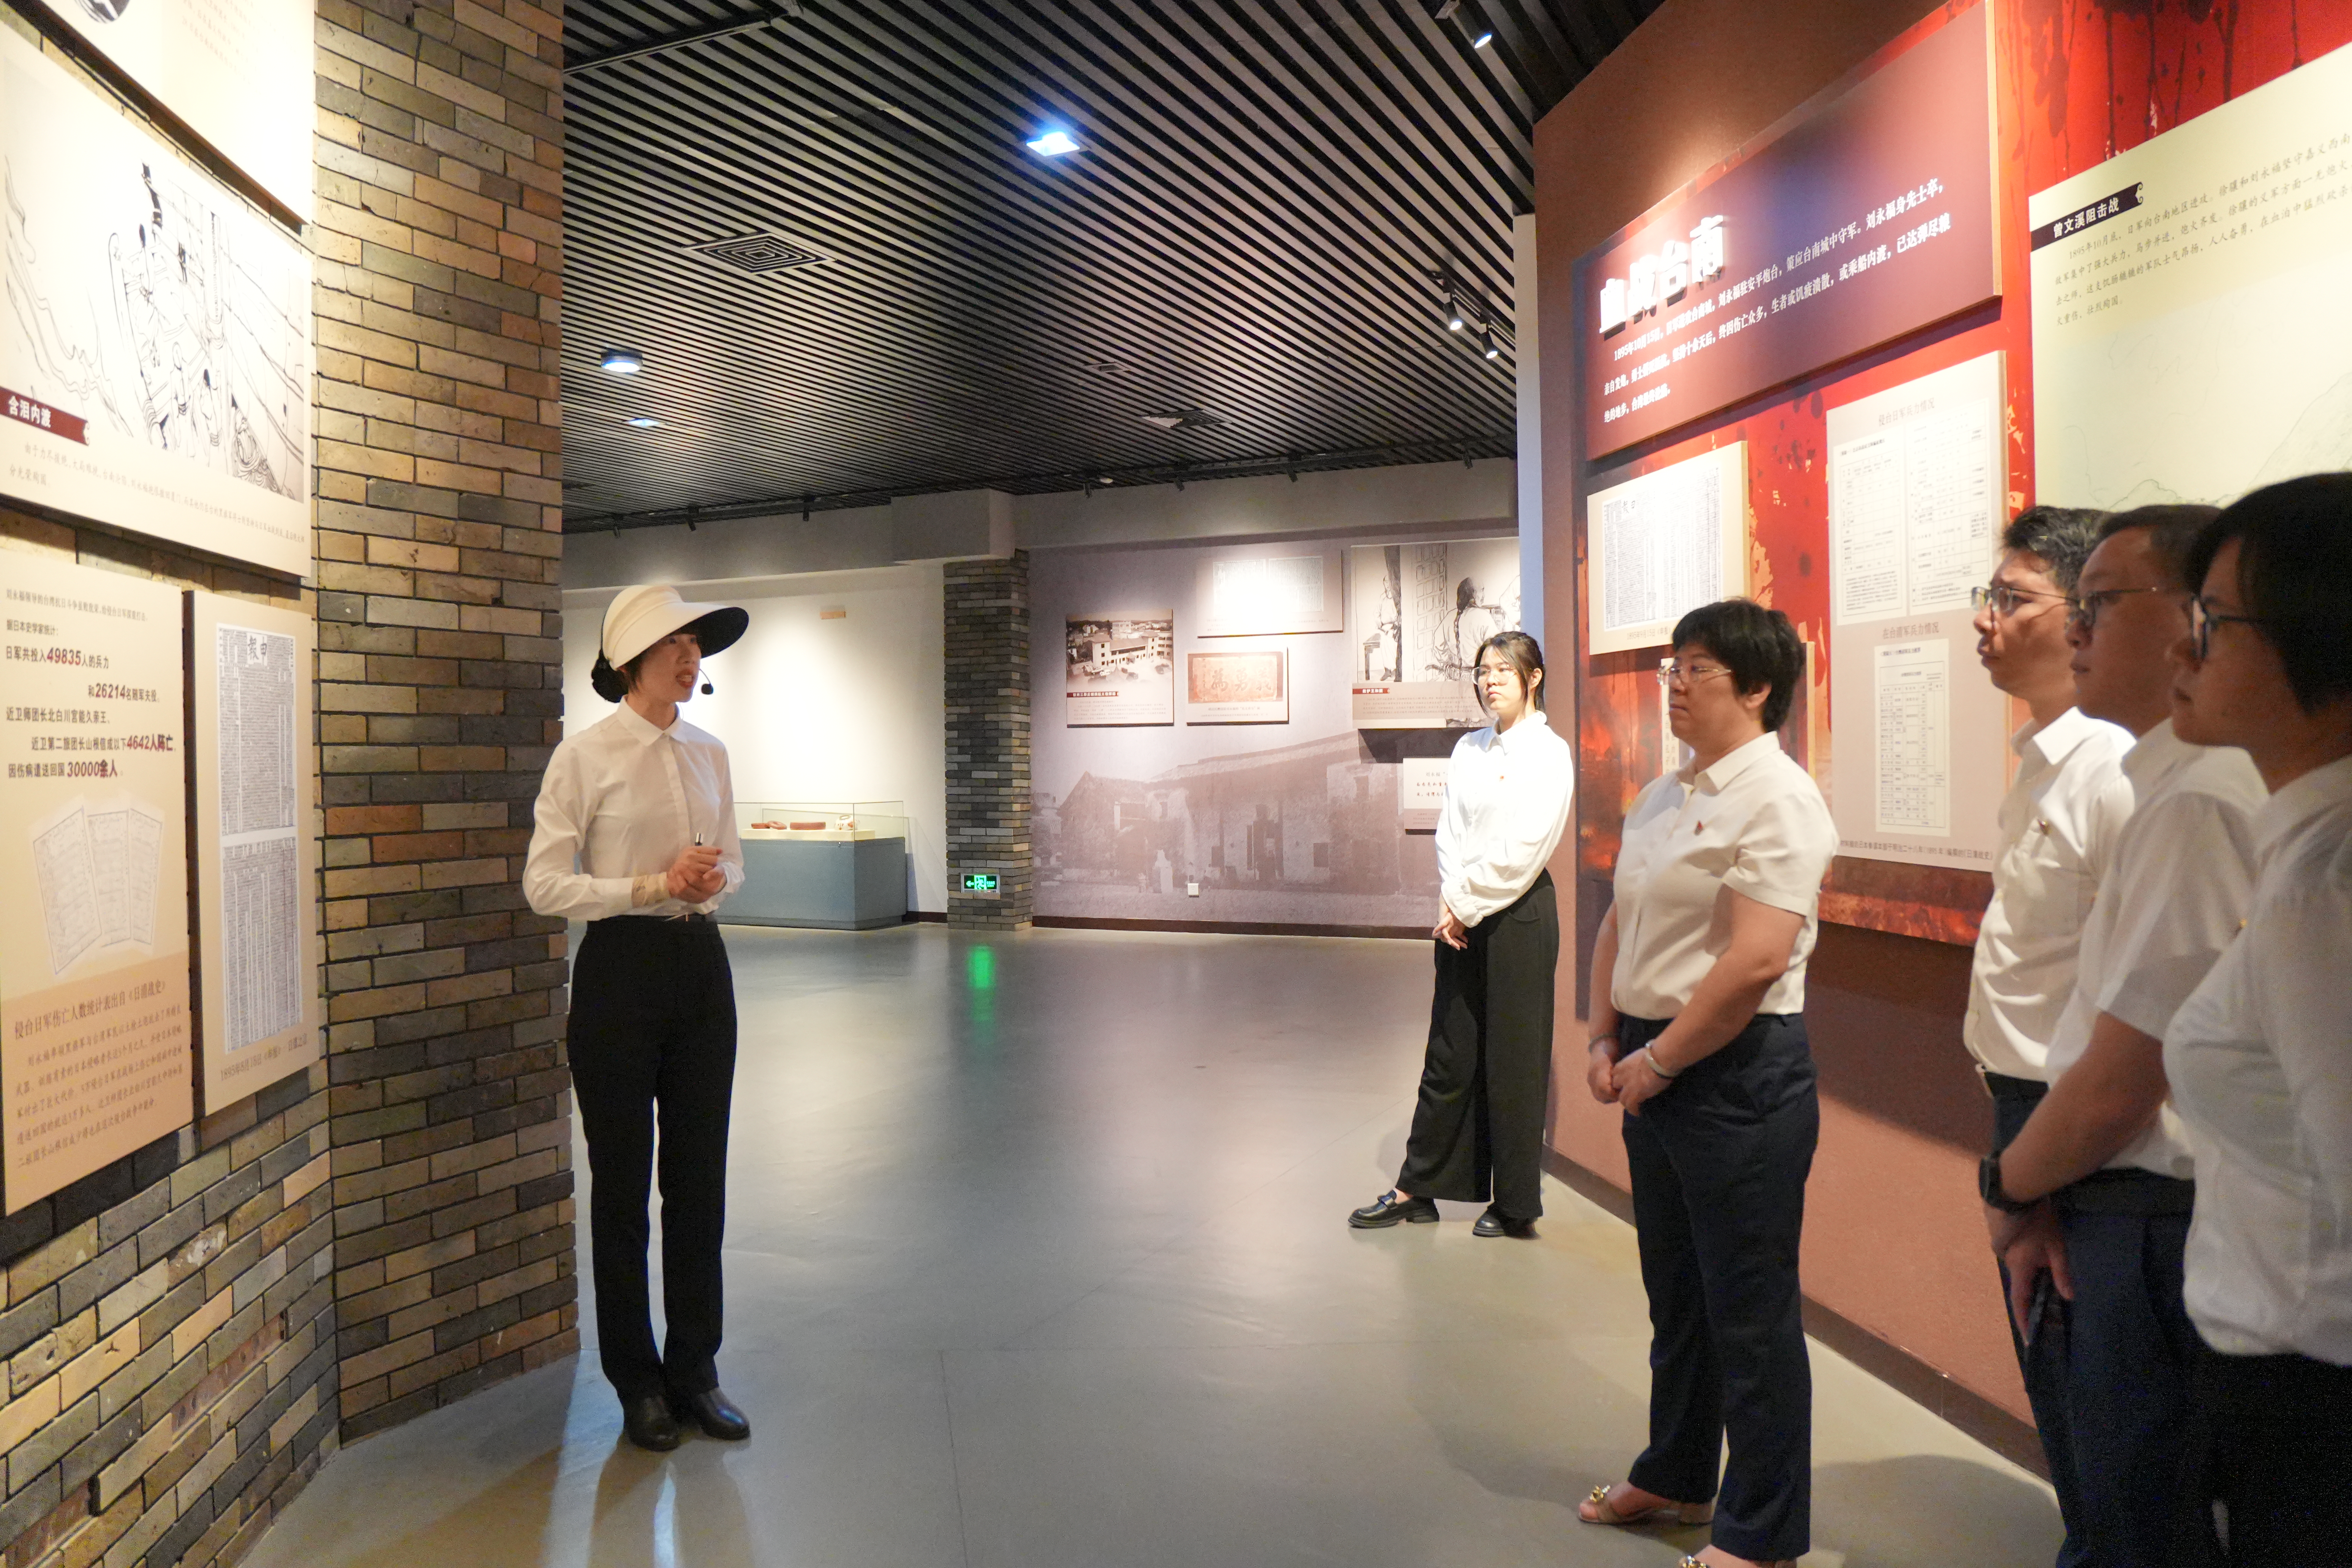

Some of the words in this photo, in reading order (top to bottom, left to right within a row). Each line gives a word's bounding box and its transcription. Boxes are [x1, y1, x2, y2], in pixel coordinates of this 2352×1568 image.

[2053, 198, 2120, 238] 曾文溪阻击战
[1599, 214, 1724, 334] 血战台南
[8, 396, 51, 428] 含泪内渡
[6, 646, 109, 669] 日军共投入49835人的兵力
